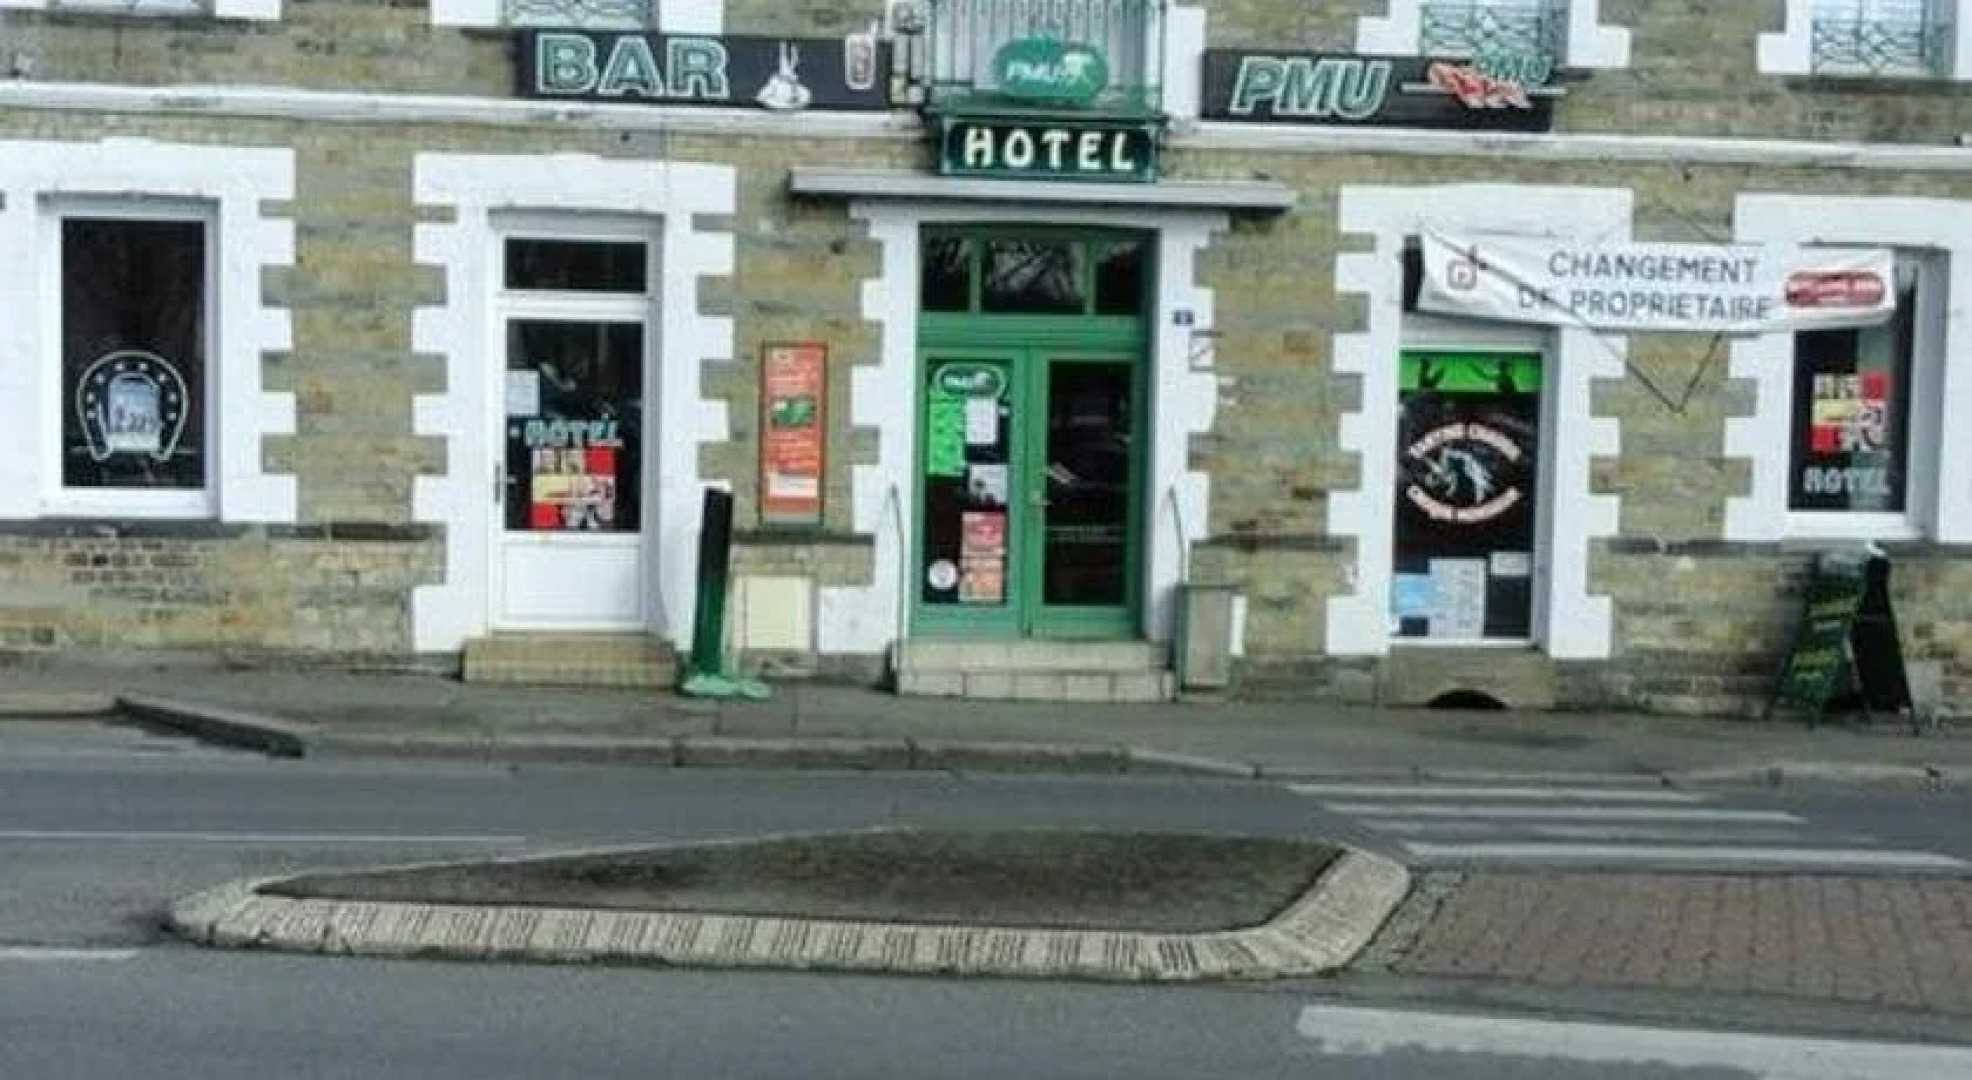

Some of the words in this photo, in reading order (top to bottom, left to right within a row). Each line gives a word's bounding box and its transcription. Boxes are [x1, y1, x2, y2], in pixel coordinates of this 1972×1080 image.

[536, 33, 729, 99] BAR
[1230, 56, 1391, 118] PMU
[964, 128, 1134, 170] HOTEL
[1548, 251, 1757, 283] CHANGEMENT
[1571, 289, 1773, 319] PROPRIETAIRE
